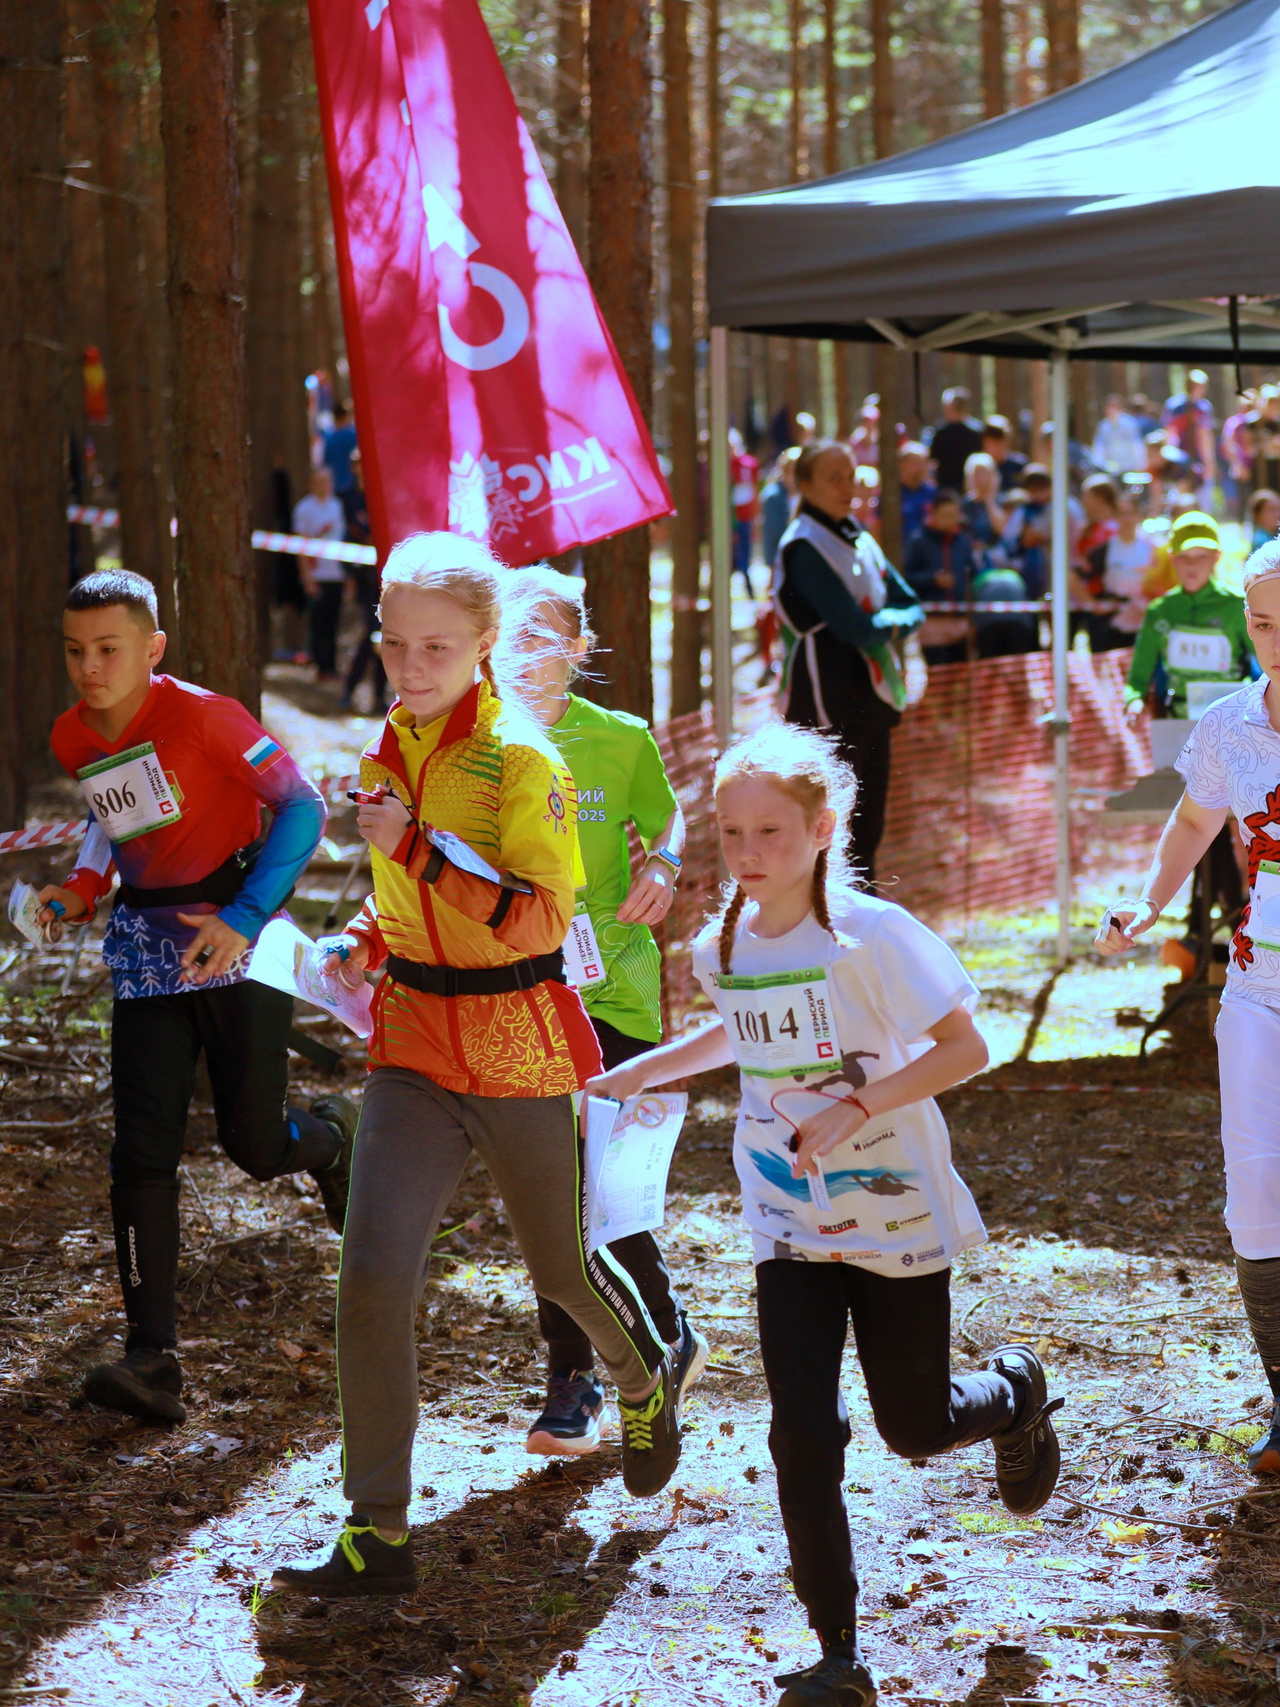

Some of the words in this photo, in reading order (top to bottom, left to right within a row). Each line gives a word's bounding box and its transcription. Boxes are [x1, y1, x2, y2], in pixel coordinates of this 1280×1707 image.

[93, 780, 136, 818] 806
[142, 760, 161, 800] ПЕРМСКИЙ
[152, 766, 168, 798] ПЕРИОД
[578, 809, 606, 822] 025
[570, 921, 588, 963] ПЕРМСКИЙ
[581, 929, 595, 962] ПЕРИОД
[733, 1007, 799, 1044] 1014
[804, 988, 822, 1039] ПЕРМСКИЙ
[817, 998, 830, 1038] ПЕРИОД
[128, 1226, 138, 1270] NORD
